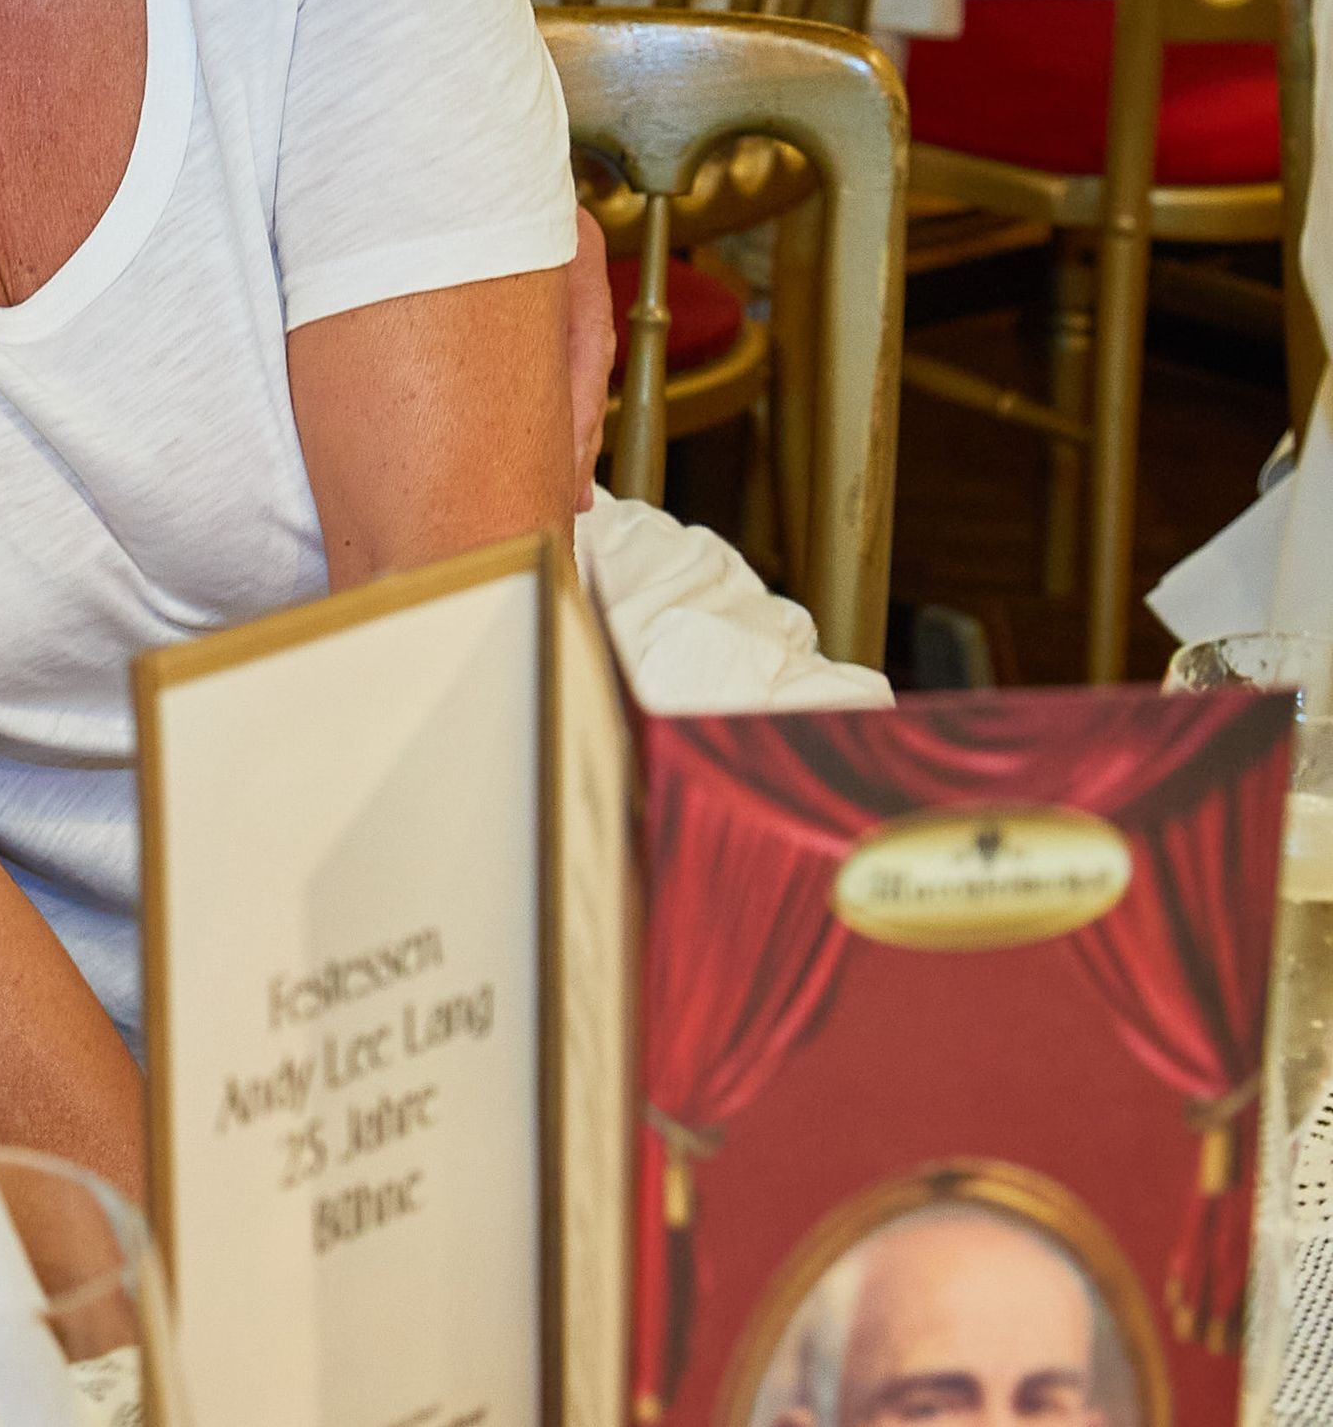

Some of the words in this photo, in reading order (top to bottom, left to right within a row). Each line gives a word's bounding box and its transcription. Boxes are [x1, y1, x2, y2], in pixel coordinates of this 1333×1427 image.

[265, 922, 445, 1034] Festessen
[212, 1052, 317, 1140] Andy
[322, 1024, 395, 1094] Lee
[402, 980, 496, 1059] Lang
[276, 1114, 331, 1194] 25
[339, 1082, 439, 1166] Jahre
[310, 1165, 429, 1259] Bühne
